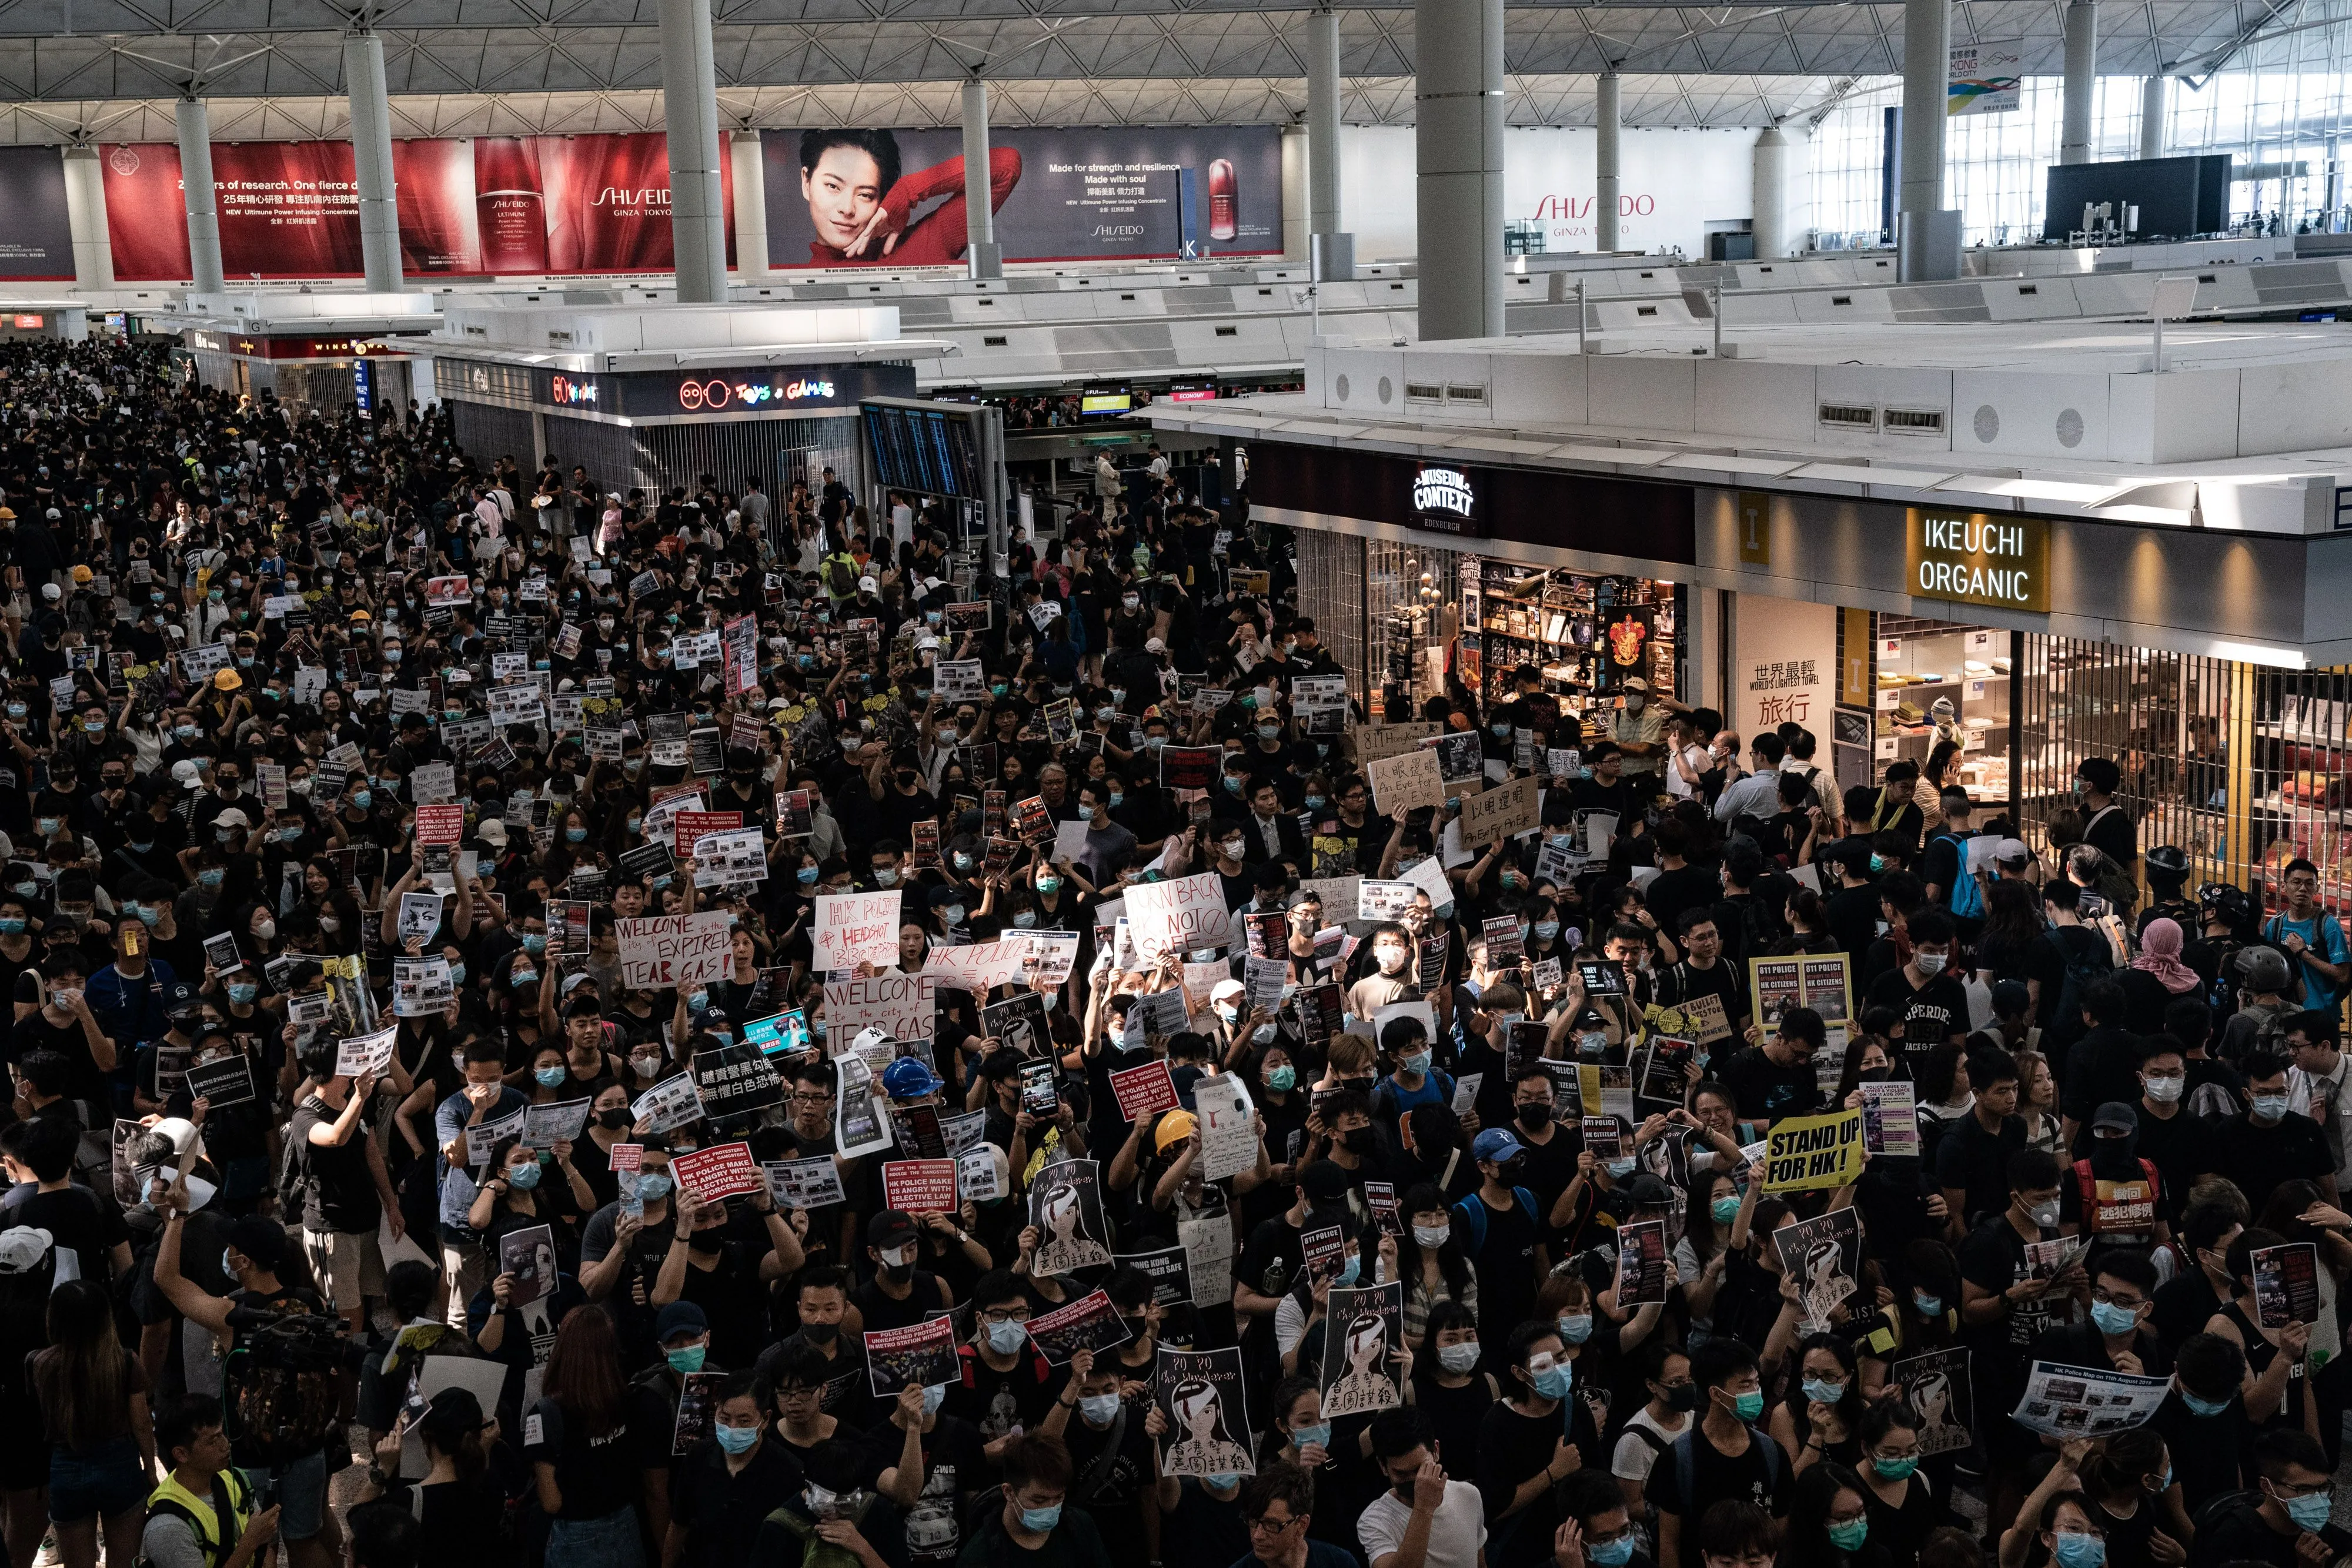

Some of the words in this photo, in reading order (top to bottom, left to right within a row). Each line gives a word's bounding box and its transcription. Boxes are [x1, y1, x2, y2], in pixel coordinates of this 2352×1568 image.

[1088, 163, 1122, 173] strength
[228, 180, 238, 189] of
[241, 180, 291, 189] research.
[294, 181, 316, 189] One
[318, 180, 349, 190] fierce
[1087, 188, 1115, 196] 捍衛美肌
[1117, 187, 1145, 195] 傾力打造
[223, 195, 283, 205] 25年精心研發
[492, 200, 530, 209] SHISEIDO
[590, 187, 671, 205] SHISEID
[1090, 225, 1144, 236] SHISEIDO
[1553, 227, 1587, 238] GINZA
[1185, 240, 1196, 256] K
[251, 322, 260, 332] G
[607, 355, 616, 372] F
[736, 383, 770, 404] TOYS
[786, 379, 835, 400] GAMES
[1420, 469, 1465, 490] MUSEUM
[1414, 486, 1474, 517] CONTEXT
[1424, 518, 1461, 531] EDINBURGH
[1926, 519, 2023, 557] IKEUCHI
[1919, 561, 2029, 601] ORGANIC
[1754, 660, 1816, 681] 世界最輕
[1750, 678, 1774, 691] WORLD'S
[1775, 677, 1800, 689] LIGHTEST
[1802, 675, 1820, 686] TOWEL
[1759, 693, 1810, 726] 旅行
[417, 772, 428, 781] HK
[431, 769, 450, 779] POLICE
[1375, 757, 1438, 780] 以眼還眼
[431, 786, 452, 797] CITIZENS
[1379, 781, 1392, 794] An
[1396, 780, 1412, 794] Eye
[1418, 775, 1435, 788] for
[1391, 794, 1404, 806] An
[1411, 791, 1435, 803] Eye
[1471, 785, 1524, 820] 以眼還眼
[1465, 833, 1476, 844] An
[1478, 829, 1489, 841] Eye
[1491, 824, 1502, 835] For
[1505, 818, 1516, 830] An
[1516, 814, 1529, 826] Eye
[1125, 882, 1172, 909] TURN
[1175, 875, 1221, 904] BACK
[830, 901, 858, 925] HK
[864, 897, 900, 920] POLICE
[616, 913, 694, 939] WELCOME
[699, 925, 707, 933] to
[710, 922, 725, 930] the
[1168, 908, 1202, 934] NOT
[1496, 918, 1515, 928] POLICE
[622, 941, 642, 951] city
[647, 935, 657, 947] of
[658, 931, 731, 958] EXPIRED
[842, 922, 889, 950] HEADSHOT
[1142, 931, 1204, 959] SAFE
[1496, 932, 1519, 942] CITIZENS
[833, 948, 866, 968] BBC
[926, 947, 959, 967] HK
[965, 935, 1030, 965] POLICE
[623, 960, 674, 985] TEAR
[1772, 965, 1796, 974] POLICE
[1806, 964, 1817, 972] 811
[1819, 963, 1842, 971] POLICE
[825, 975, 935, 1006] WELCOME
[1770, 980, 1798, 988] CITIZENS
[831, 1011, 846, 1022] to
[858, 1009, 873, 1018] the
[881, 1007, 901, 1018] city
[910, 1002, 921, 1012] of
[896, 1015, 933, 1041] GAS
[705, 1072, 781, 1102] 無懼白色恐怖
[1770, 1124, 1836, 1158] STAND
[1839, 1116, 1860, 1145] UP
[1767, 1156, 1806, 1185] FOR
[891, 1193, 932, 1202] SELECTIVE
[1763, 1184, 1809, 1193] thestandnews.com
[2113, 1187, 2141, 1201] 撤回
[893, 1201, 950, 1209] ENFORCEMENT
[2099, 1202, 2153, 1221] 逃犯修例
[1150, 1256, 1170, 1268] KONG
[871, 1333, 913, 1345] UNWEAPONED
[914, 1324, 946, 1336] PROTESTER
[875, 1341, 896, 1349] METRO
[896, 1338, 921, 1347] STATION
[921, 1332, 943, 1341] WITHIN
[880, 1329, 903, 1338] POLICE
[904, 1325, 924, 1333] SHOOT
[2064, 1368, 2082, 1376] Police
[2083, 1371, 2095, 1379] Map
[2117, 1376, 2139, 1385] August
